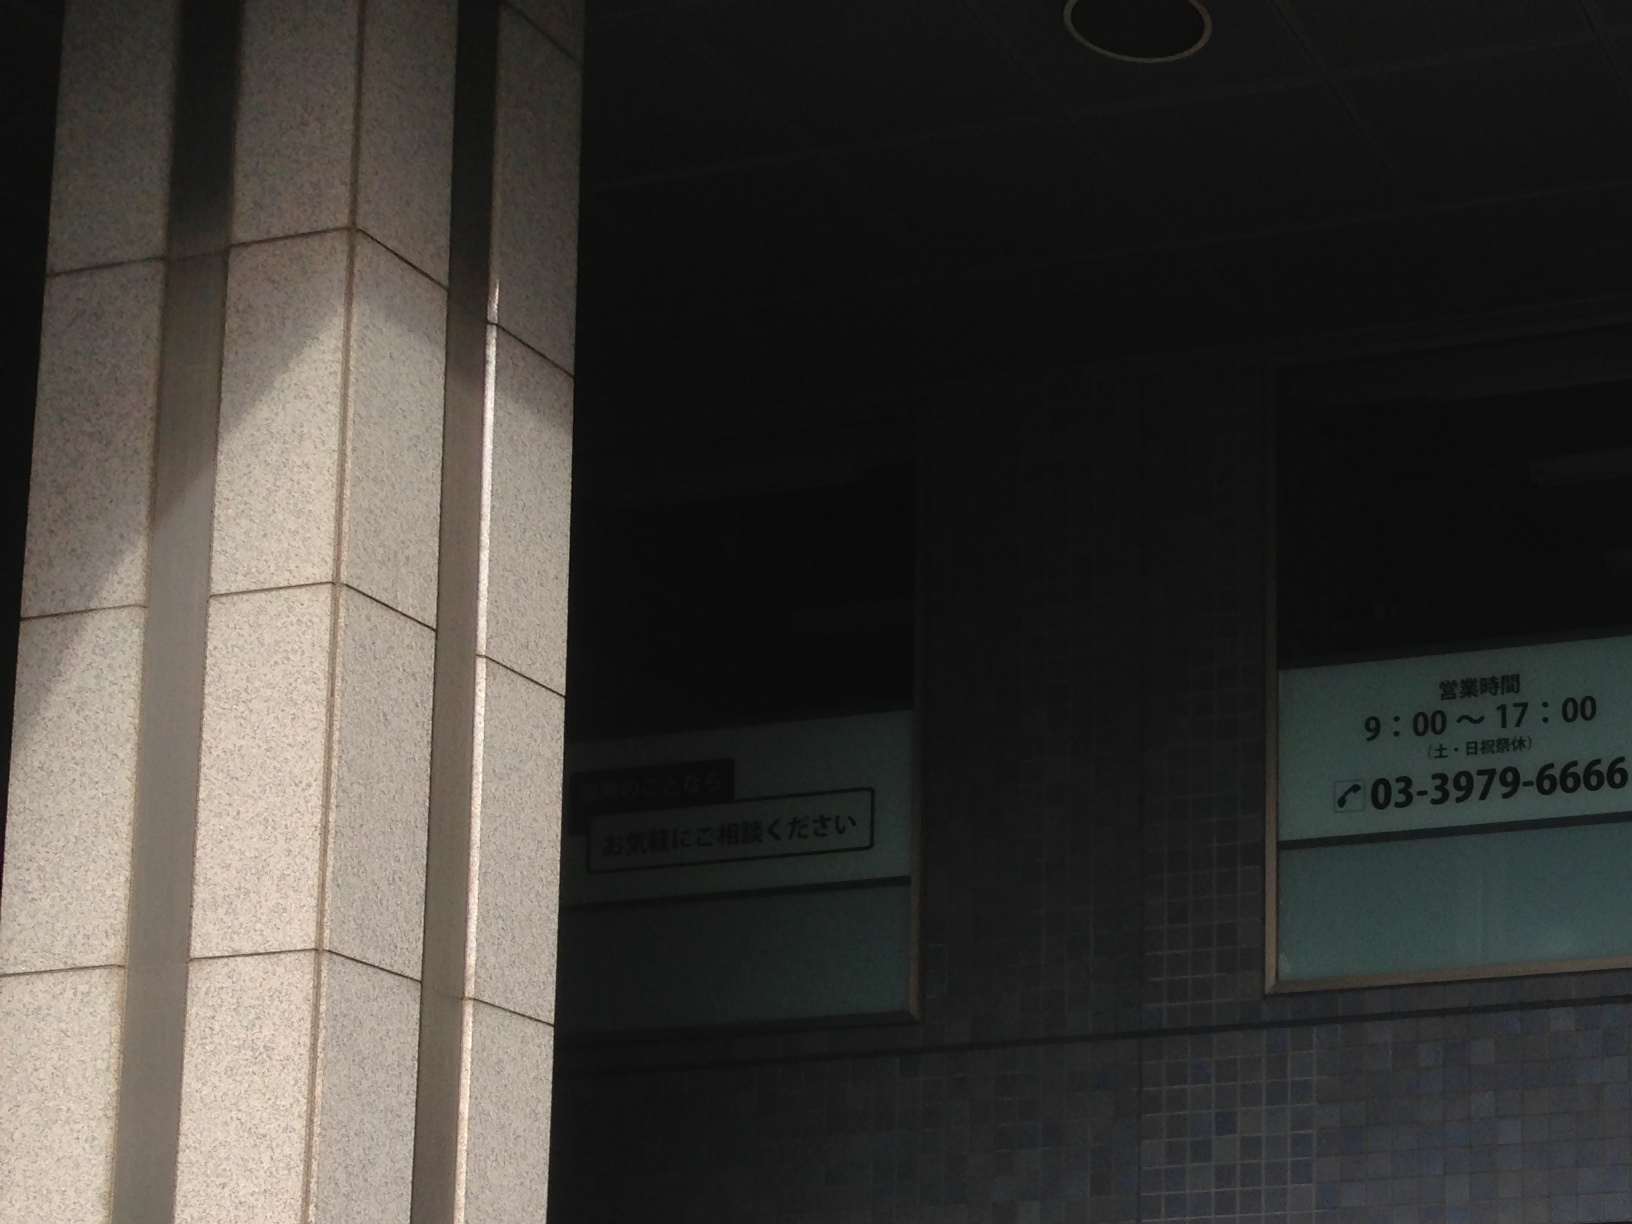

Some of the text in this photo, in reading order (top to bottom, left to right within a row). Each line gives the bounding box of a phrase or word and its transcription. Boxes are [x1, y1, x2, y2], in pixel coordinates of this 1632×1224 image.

[1438, 673, 1521, 701] 営業時間
[1371, 755, 1630, 810] 03-3979-6666
